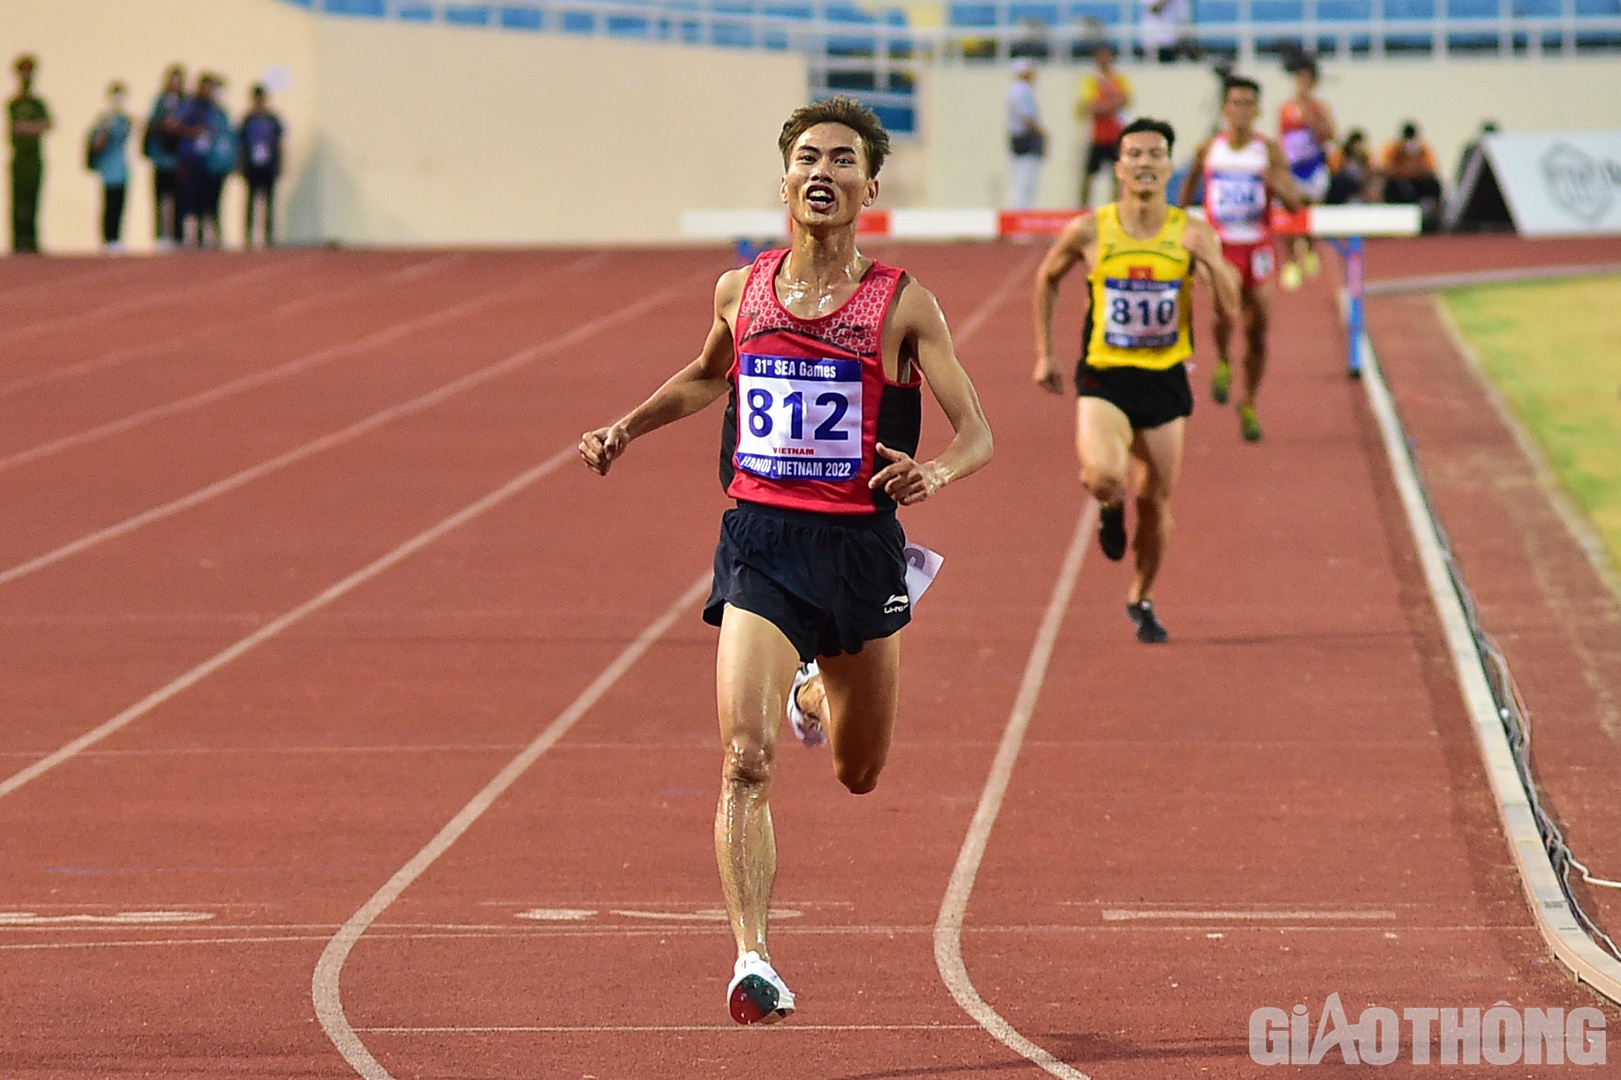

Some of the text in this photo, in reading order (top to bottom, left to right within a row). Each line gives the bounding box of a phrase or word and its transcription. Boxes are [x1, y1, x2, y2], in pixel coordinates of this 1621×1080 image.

[1112, 298, 1174, 326] 810
[774, 359, 796, 376] SEA
[799, 361, 837, 378] Games
[747, 388, 849, 440] 812
[772, 447, 815, 455] VIETNAM
[825, 462, 851, 477] 2022
